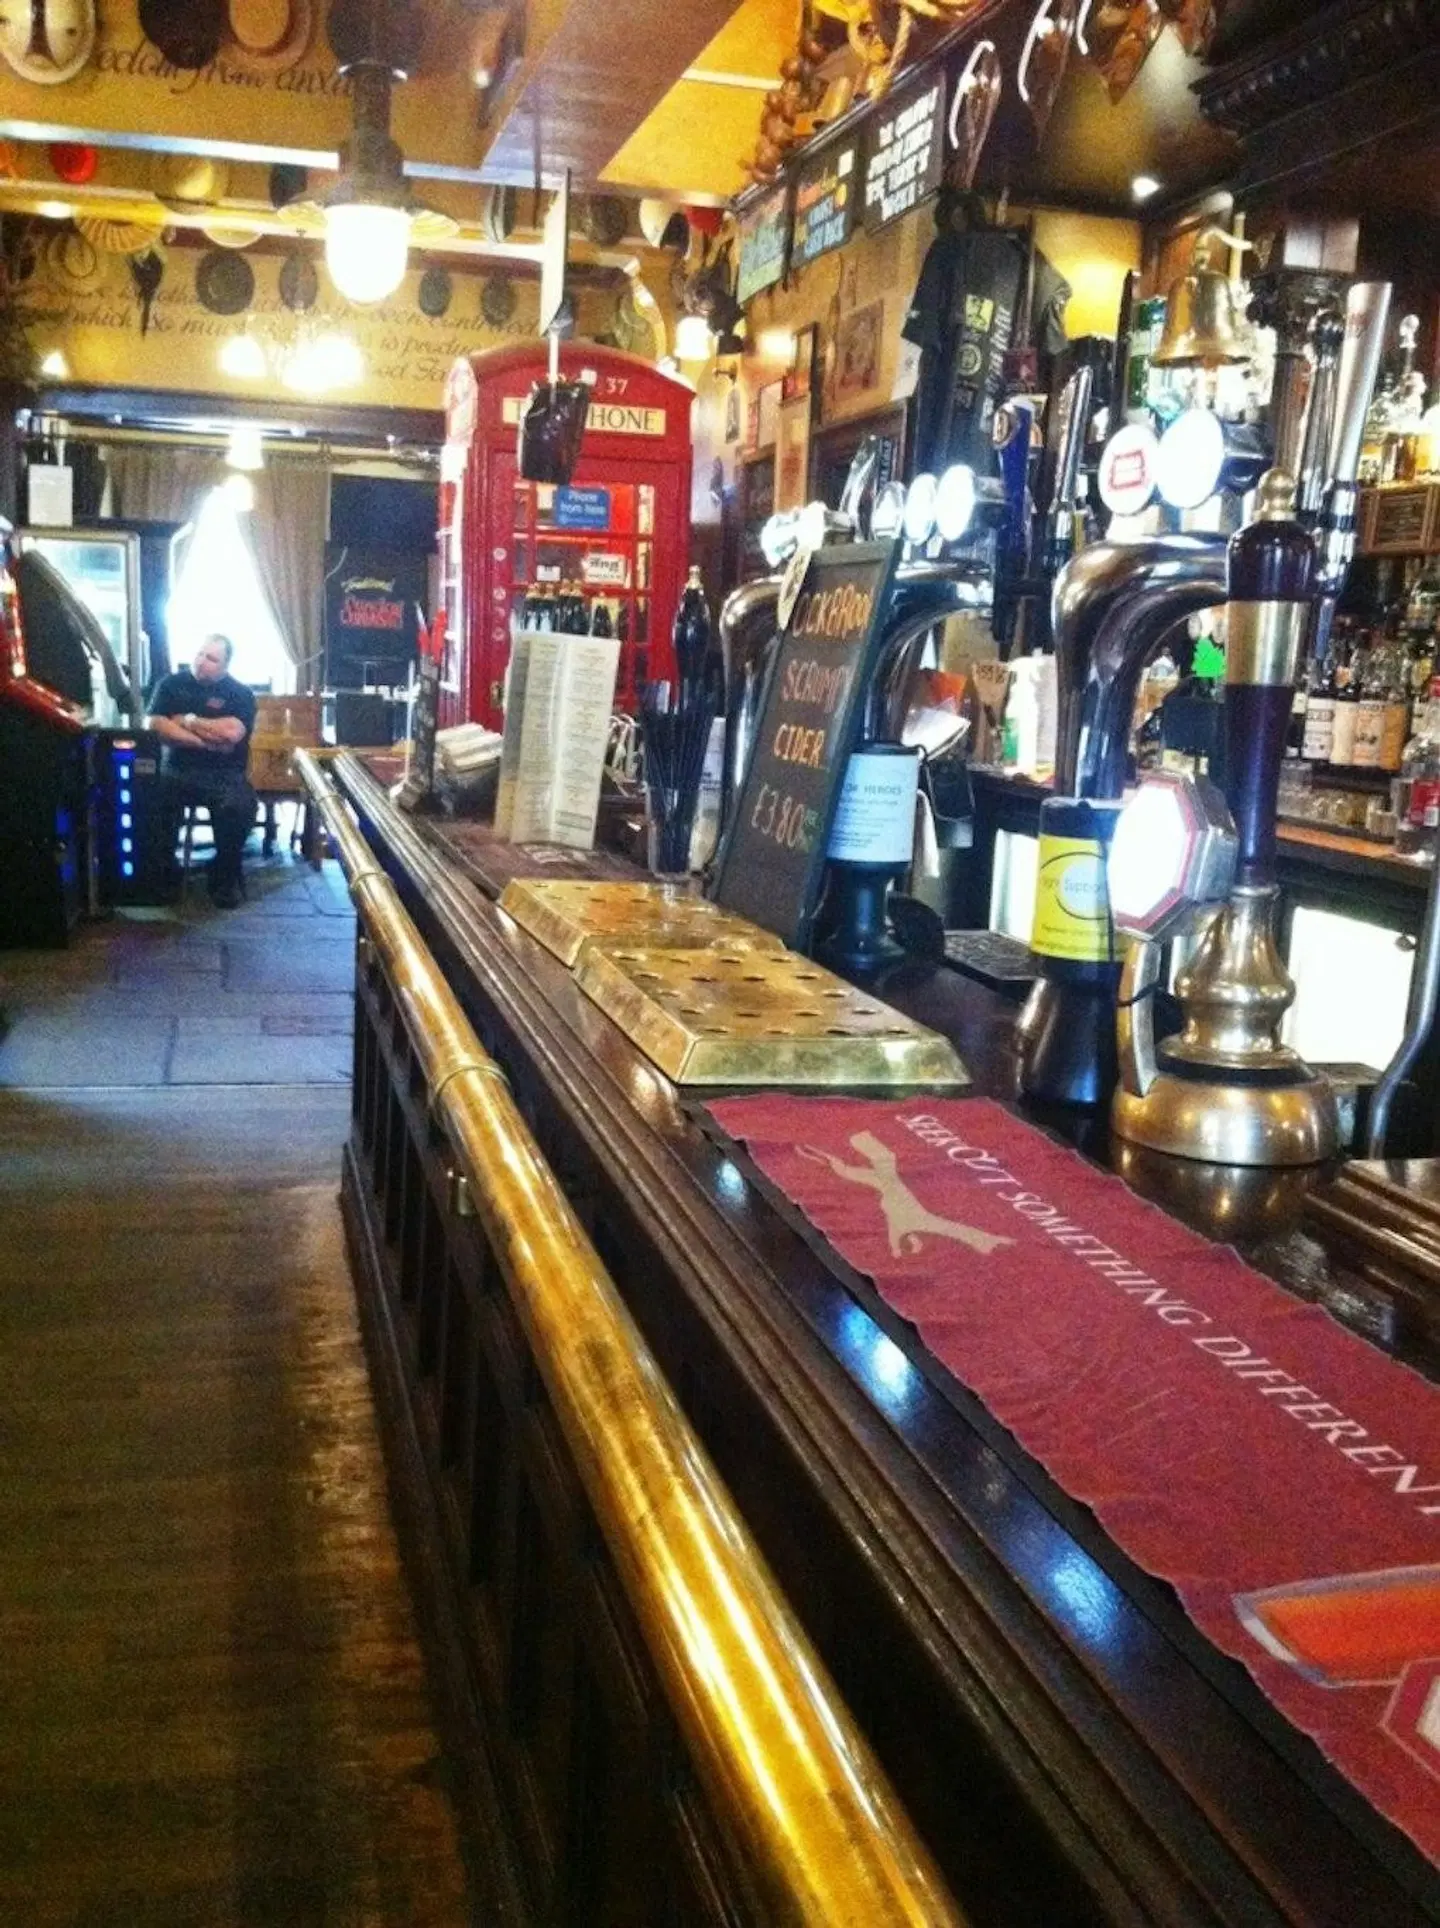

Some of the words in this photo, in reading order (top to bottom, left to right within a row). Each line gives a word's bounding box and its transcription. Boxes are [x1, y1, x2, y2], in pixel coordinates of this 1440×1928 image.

[605, 376, 629, 394] 37
[773, 721, 826, 769] CIDER
[894, 1113, 958, 1148] SEEK
[947, 1144, 1023, 1186] OUT
[996, 1191, 1213, 1326] SOMETHING
